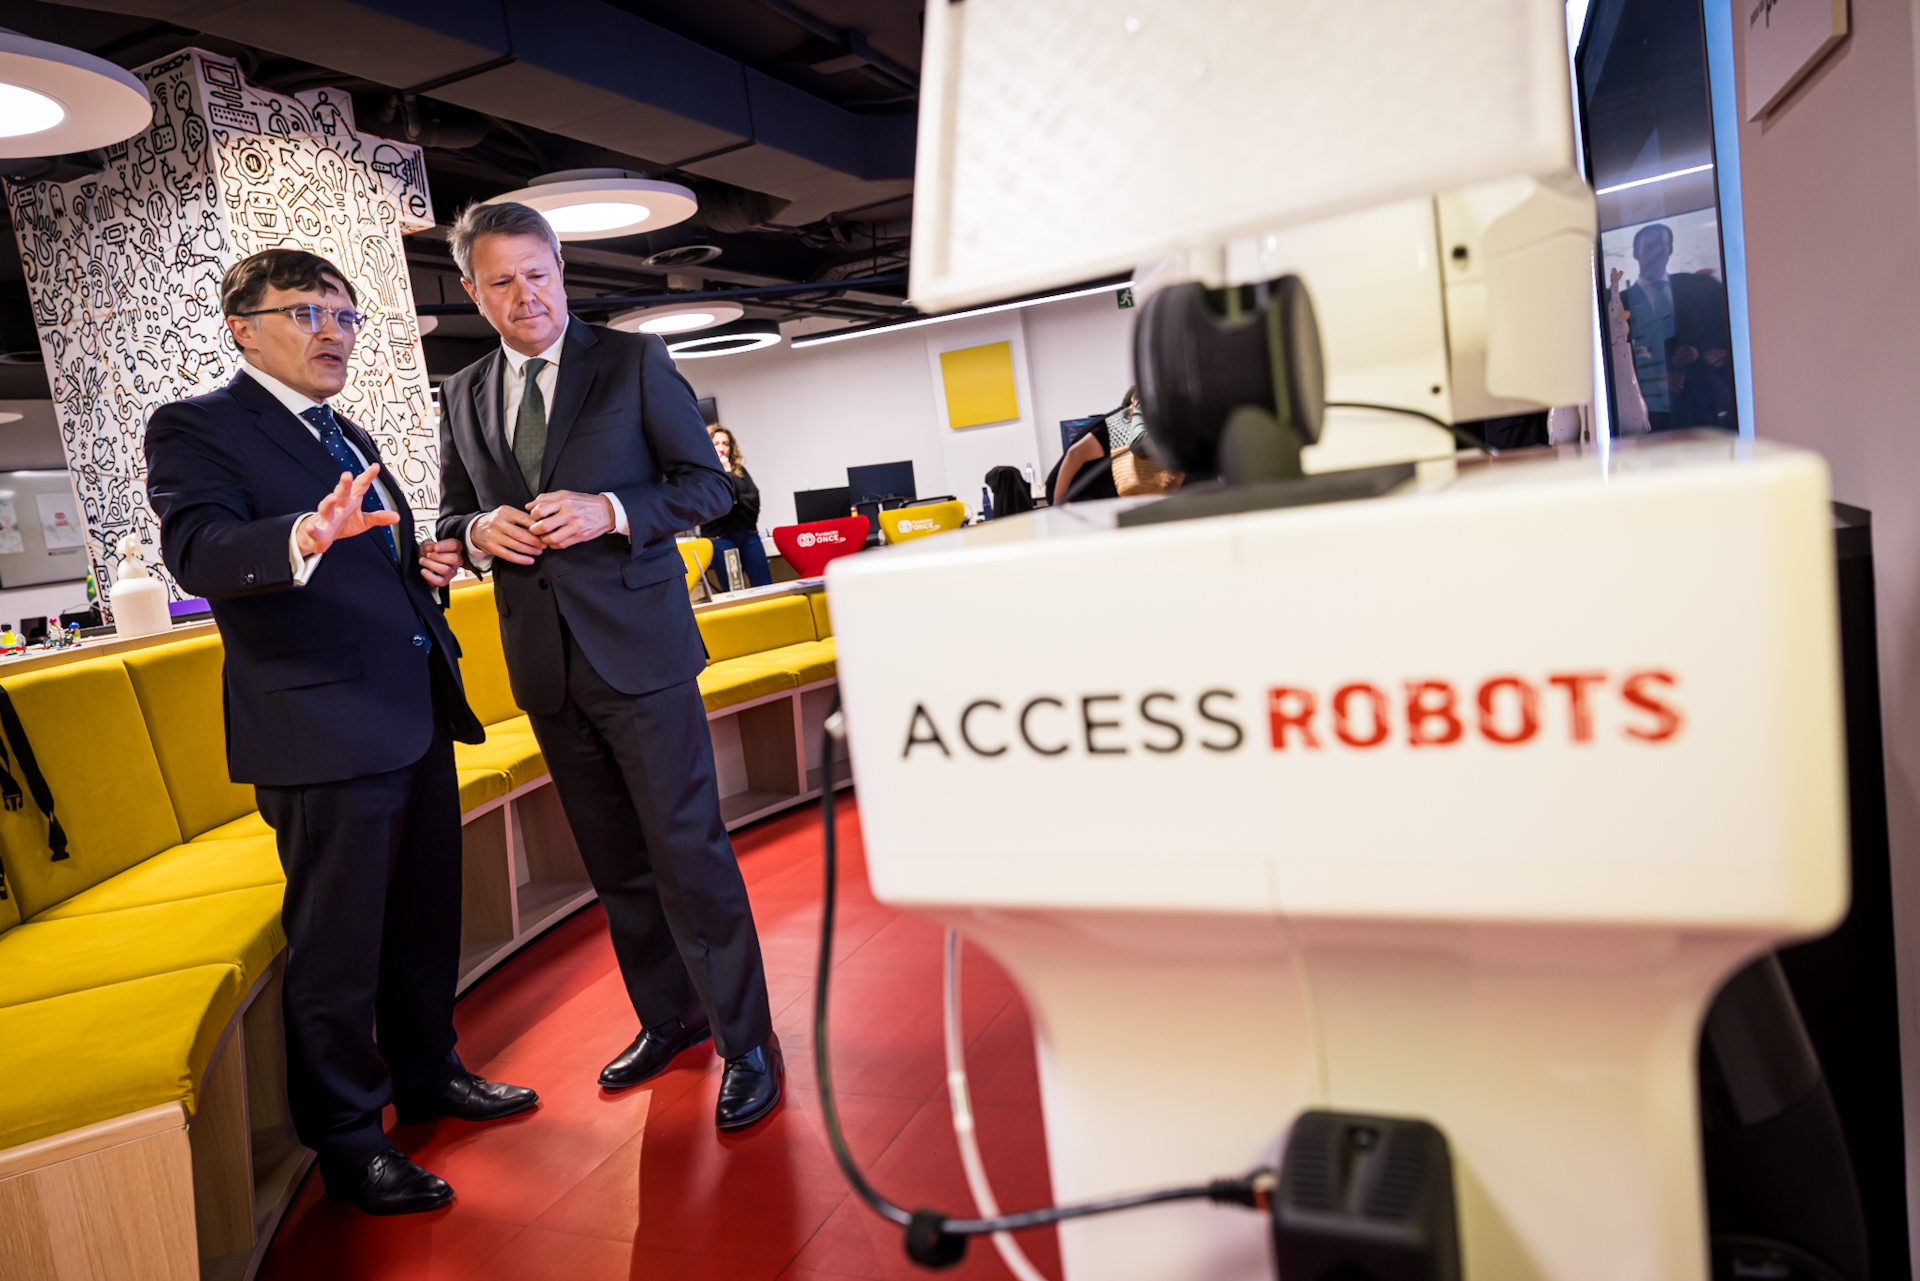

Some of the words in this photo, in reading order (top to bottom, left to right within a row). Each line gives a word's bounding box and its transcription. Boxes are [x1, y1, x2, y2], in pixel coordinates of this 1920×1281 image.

[816, 534, 839, 544] ONCE
[902, 688, 1244, 759] ACCESS
[1265, 668, 1684, 752] ROBOTS
